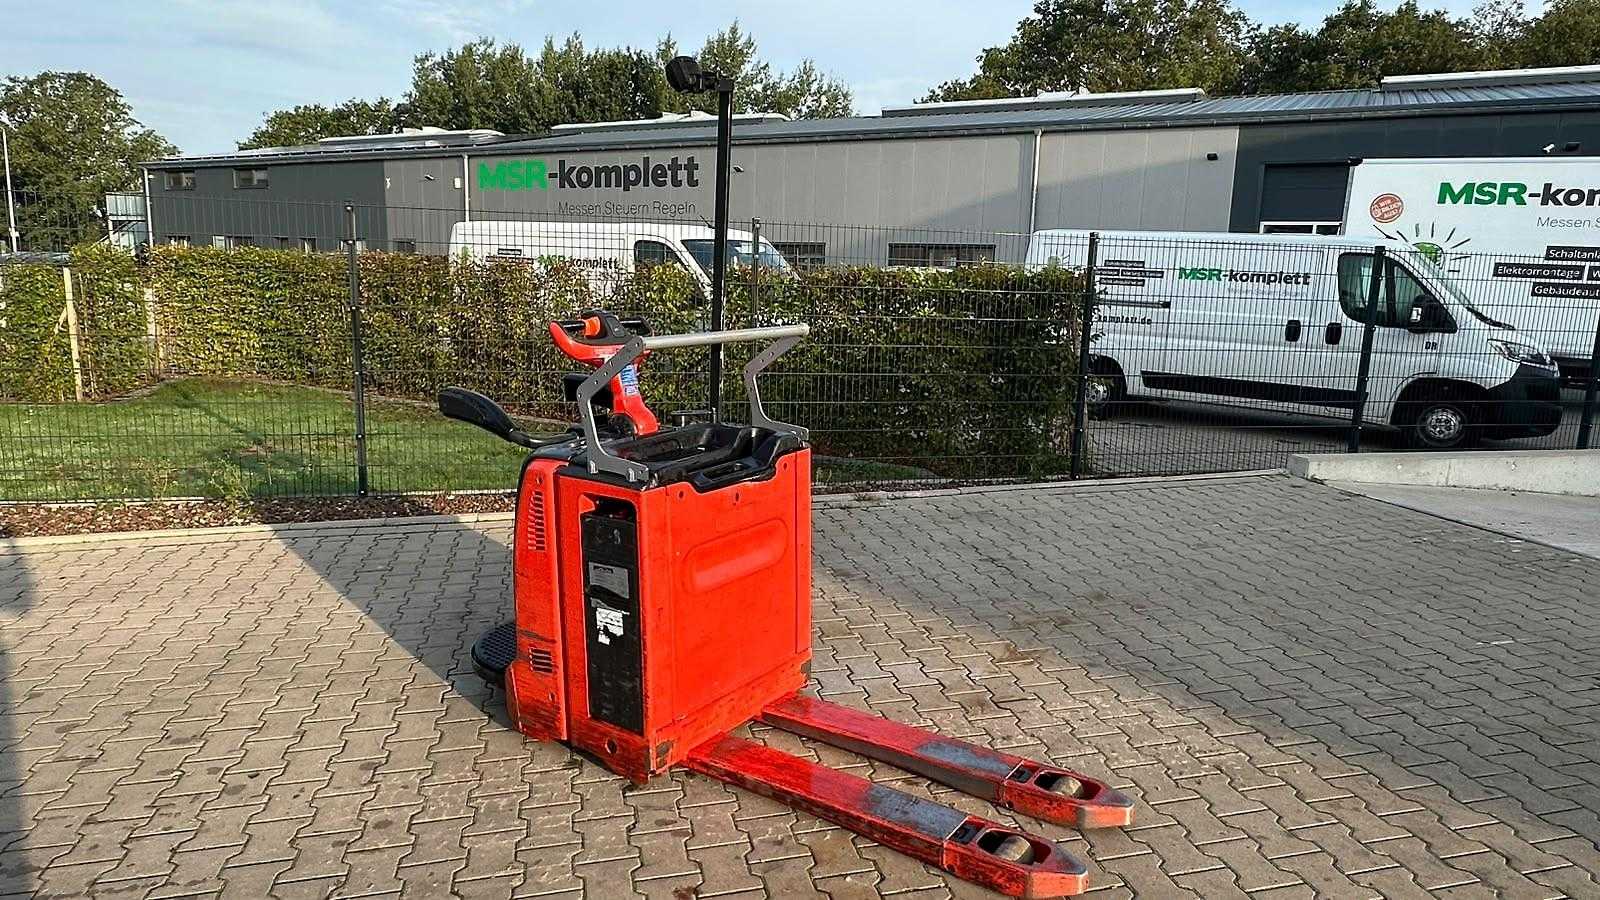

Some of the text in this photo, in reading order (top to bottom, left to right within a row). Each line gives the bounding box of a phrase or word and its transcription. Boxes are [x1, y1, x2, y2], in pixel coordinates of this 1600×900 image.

[478, 156, 699, 191] MSR-komplett
[653, 201, 696, 217] Regeln
[1178, 266, 1311, 285] MSR-komplett
[1497, 265, 1580, 279] Elektromontage
